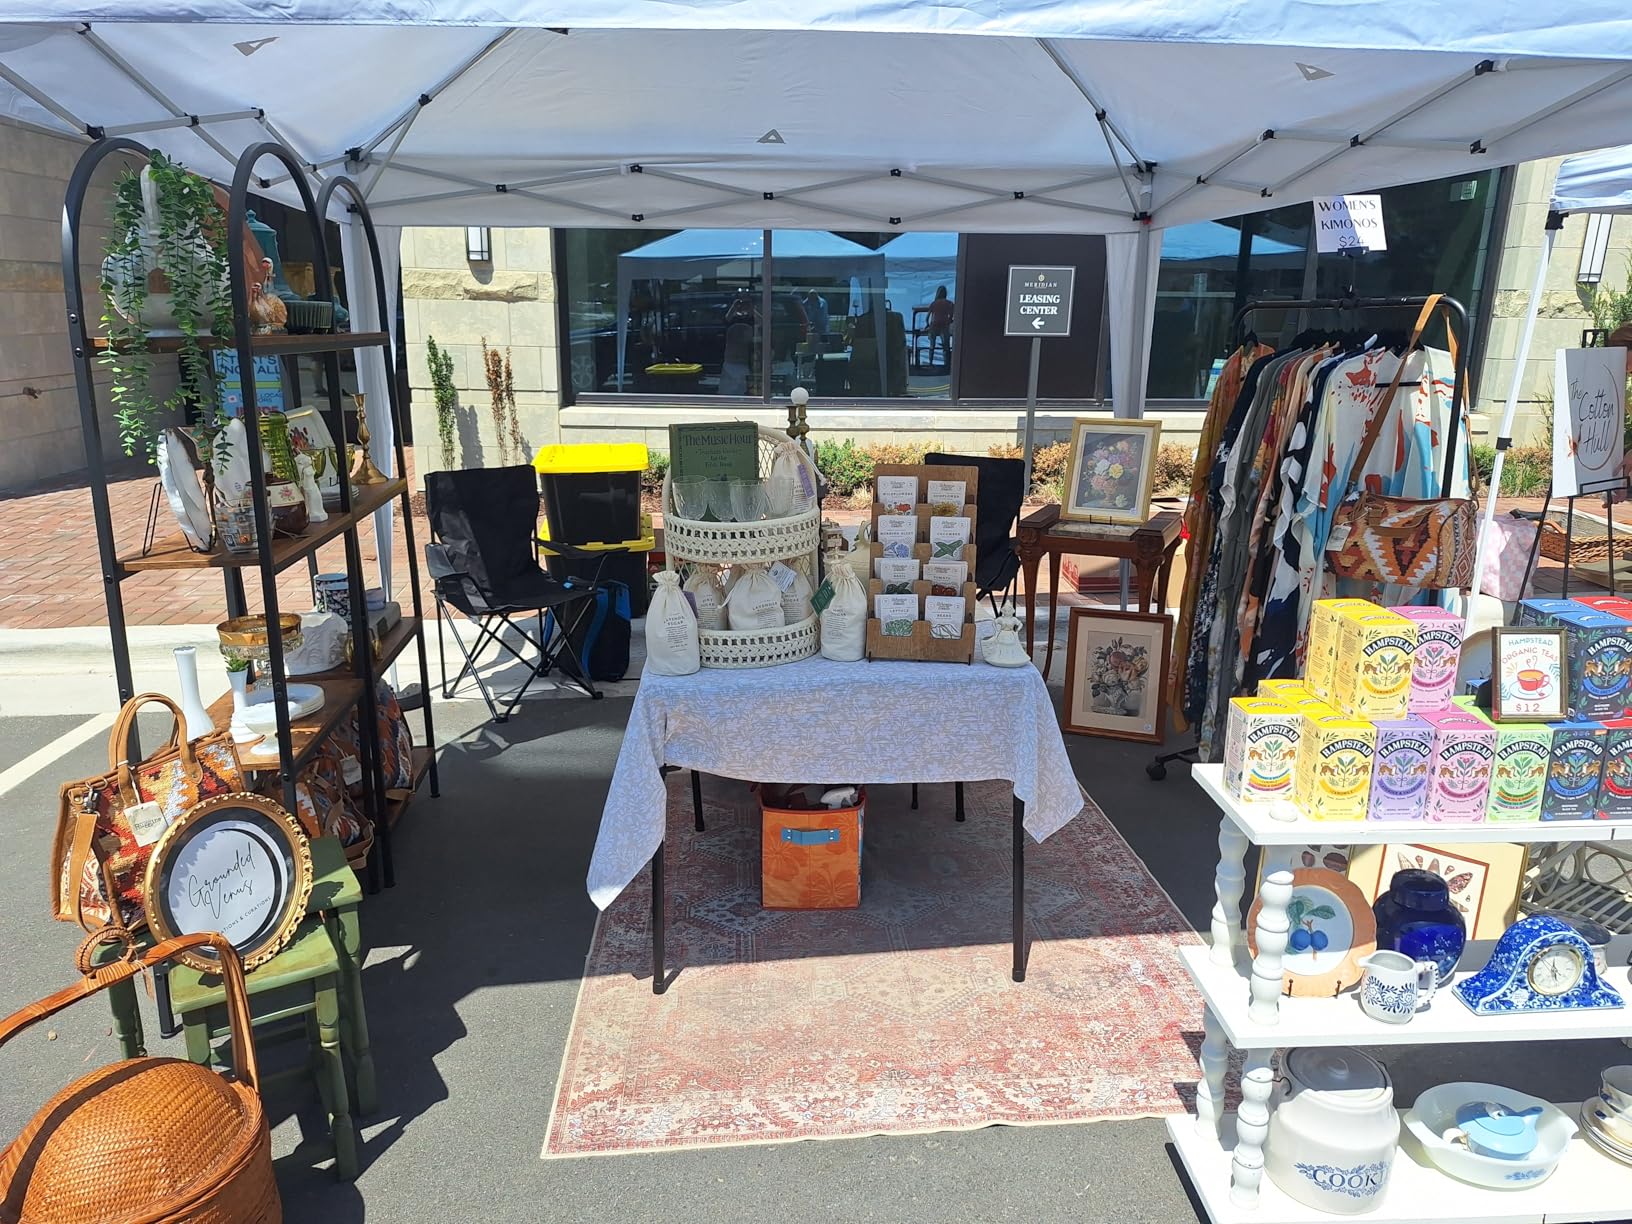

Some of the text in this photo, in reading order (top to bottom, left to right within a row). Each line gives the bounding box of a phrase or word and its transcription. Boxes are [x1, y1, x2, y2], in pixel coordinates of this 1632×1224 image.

[1318, 200, 1376, 212] WOMEN'S
[1321, 218, 1378, 230] KIMONOS
[1019, 294, 1061, 304] LEASING
[1019, 306, 1058, 315] CENTER
[1570, 379, 1582, 400] The
[1579, 389, 1615, 422] Cotton
[1583, 420, 1611, 455] Hull
[1364, 637, 1414, 655] HAMPSTEAD
[1415, 631, 1460, 649] AMPSTEAD
[1508, 637, 1553, 646] HAMPSTEAD
[1502, 647, 1538, 664] ORGANIC
[1516, 703, 1540, 713] $12
[1249, 725, 1299, 742] HAMPSTEAD
[1321, 740, 1373, 758] HAMPSTEAD
[1380, 740, 1431, 758] HAMPSTEAD
[1442, 742, 1493, 760] HAMPSTEAD
[1499, 741, 1549, 759] HAMPSTEAD
[1554, 740, 1603, 757] HAMPSTEAD
[188, 842, 256, 908] Grounded
[205, 880, 253, 920] Venus
[244, 896, 272, 917] CURATIONS
